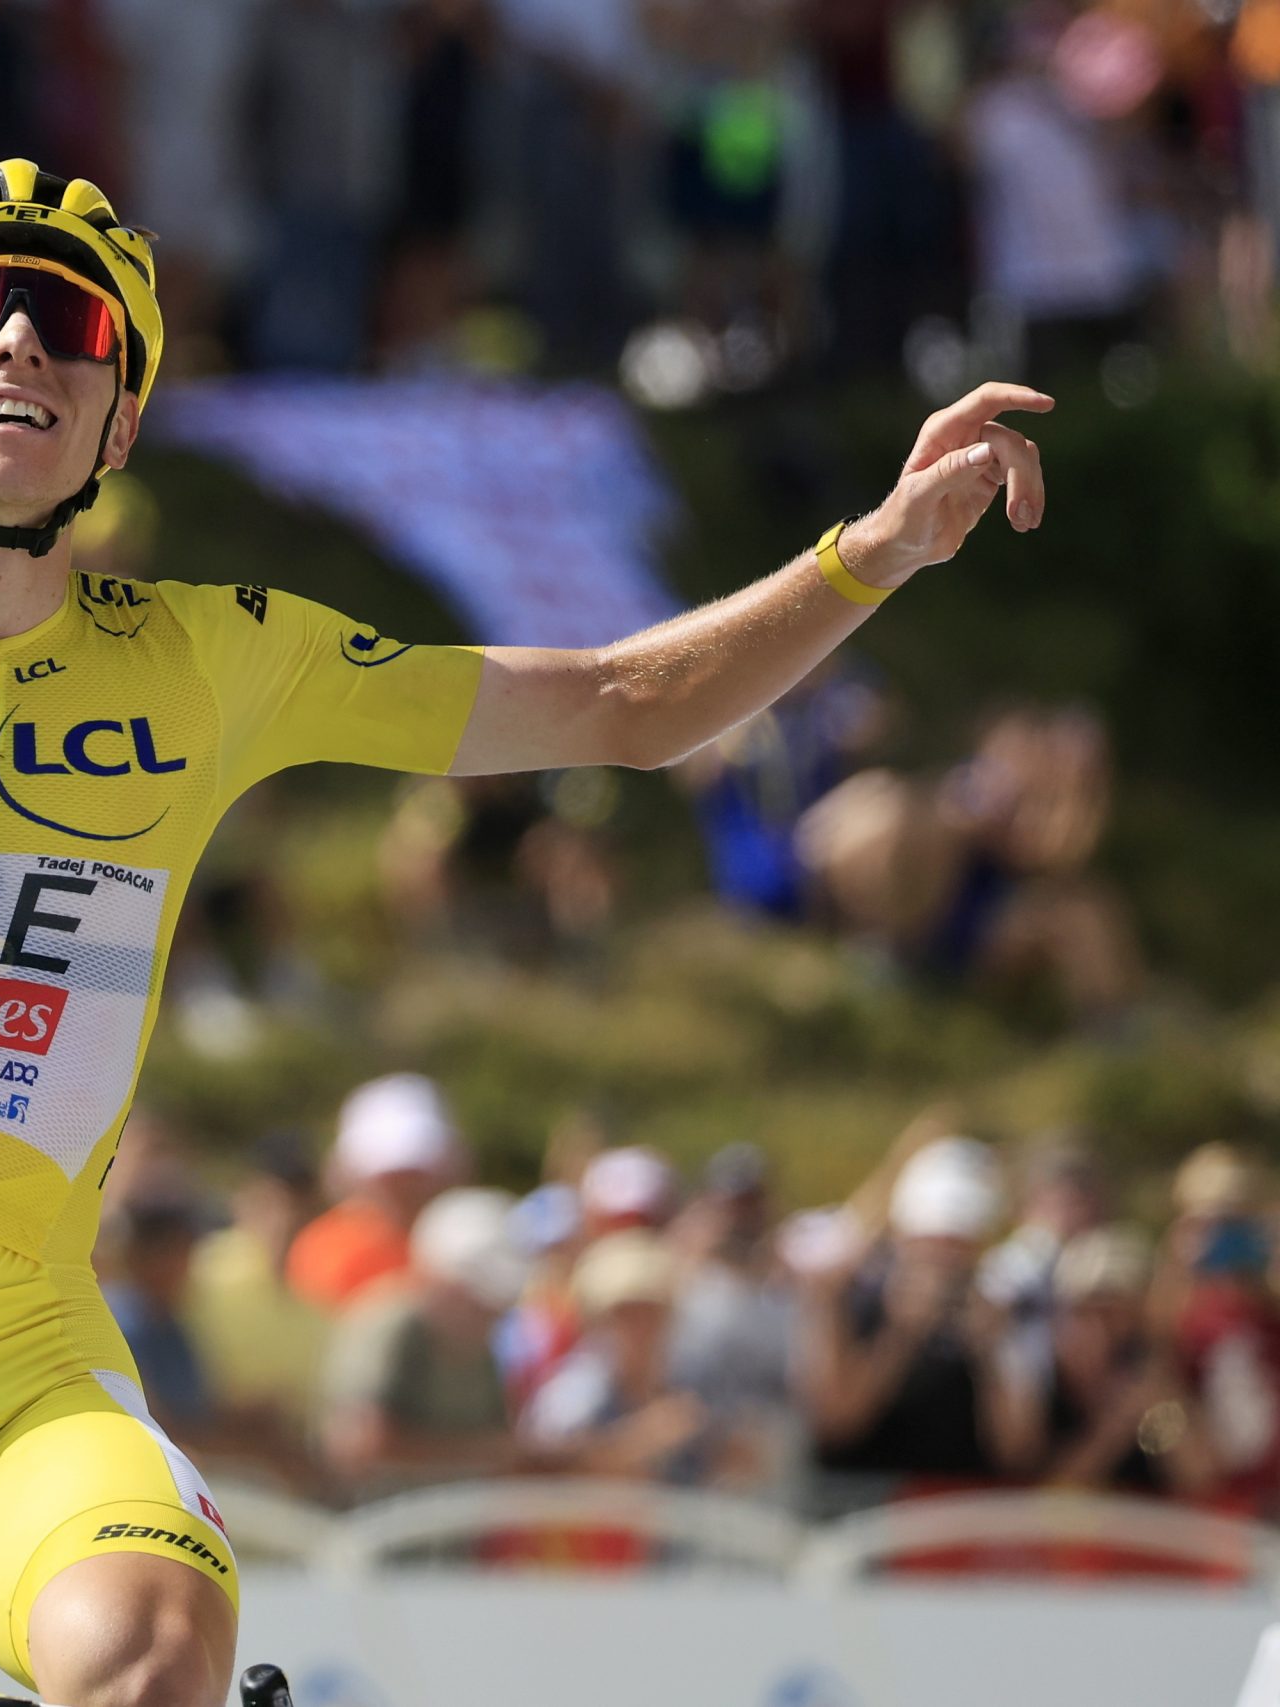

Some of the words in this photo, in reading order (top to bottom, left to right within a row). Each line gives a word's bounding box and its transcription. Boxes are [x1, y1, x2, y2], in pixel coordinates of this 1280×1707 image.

[14, 657, 67, 684] LCL
[12, 716, 187, 777] LCL
[37, 856, 86, 876] Tadej
[91, 862, 154, 894] POGACAR
[91, 1522, 229, 1575] Santini
